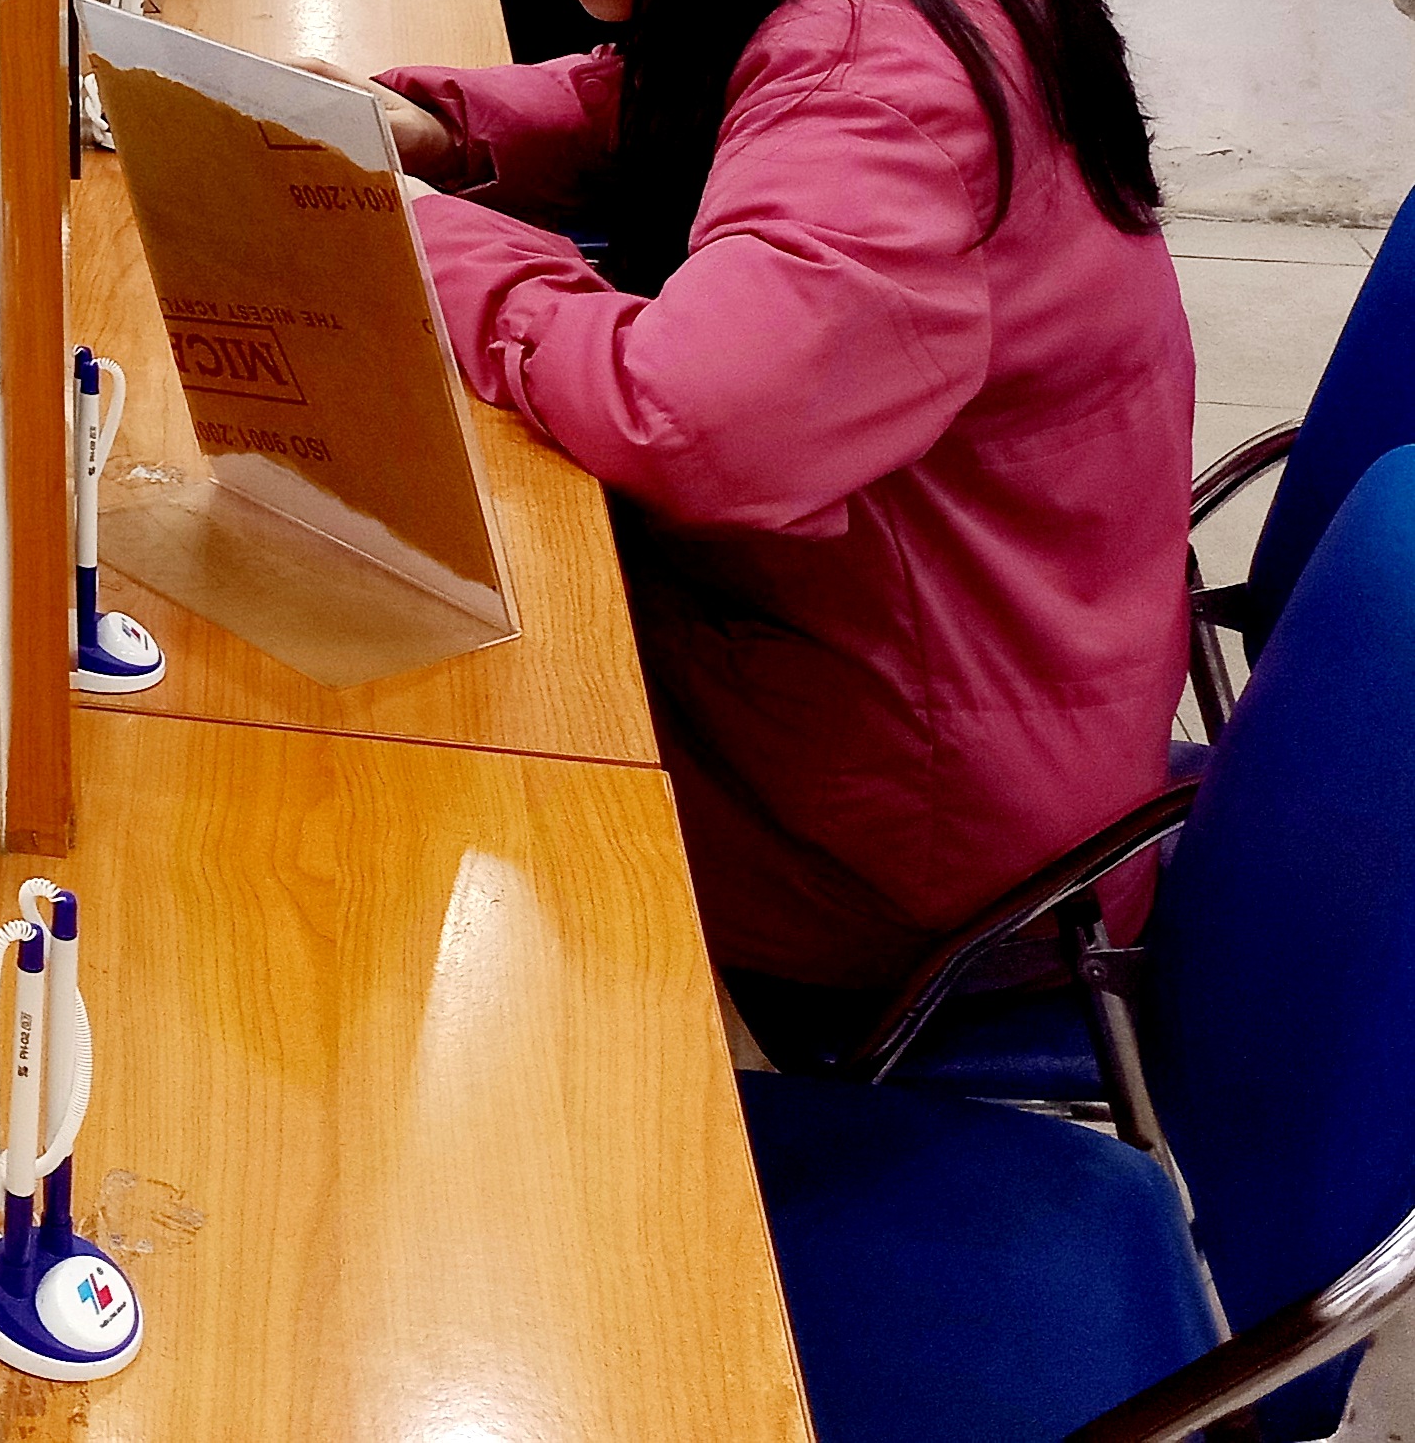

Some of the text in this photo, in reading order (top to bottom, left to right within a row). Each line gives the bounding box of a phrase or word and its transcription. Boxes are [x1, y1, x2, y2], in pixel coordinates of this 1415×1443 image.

[227, 303, 296, 325] NICEST
[298, 309, 342, 331] THE
[290, 434, 332, 462] ISO
